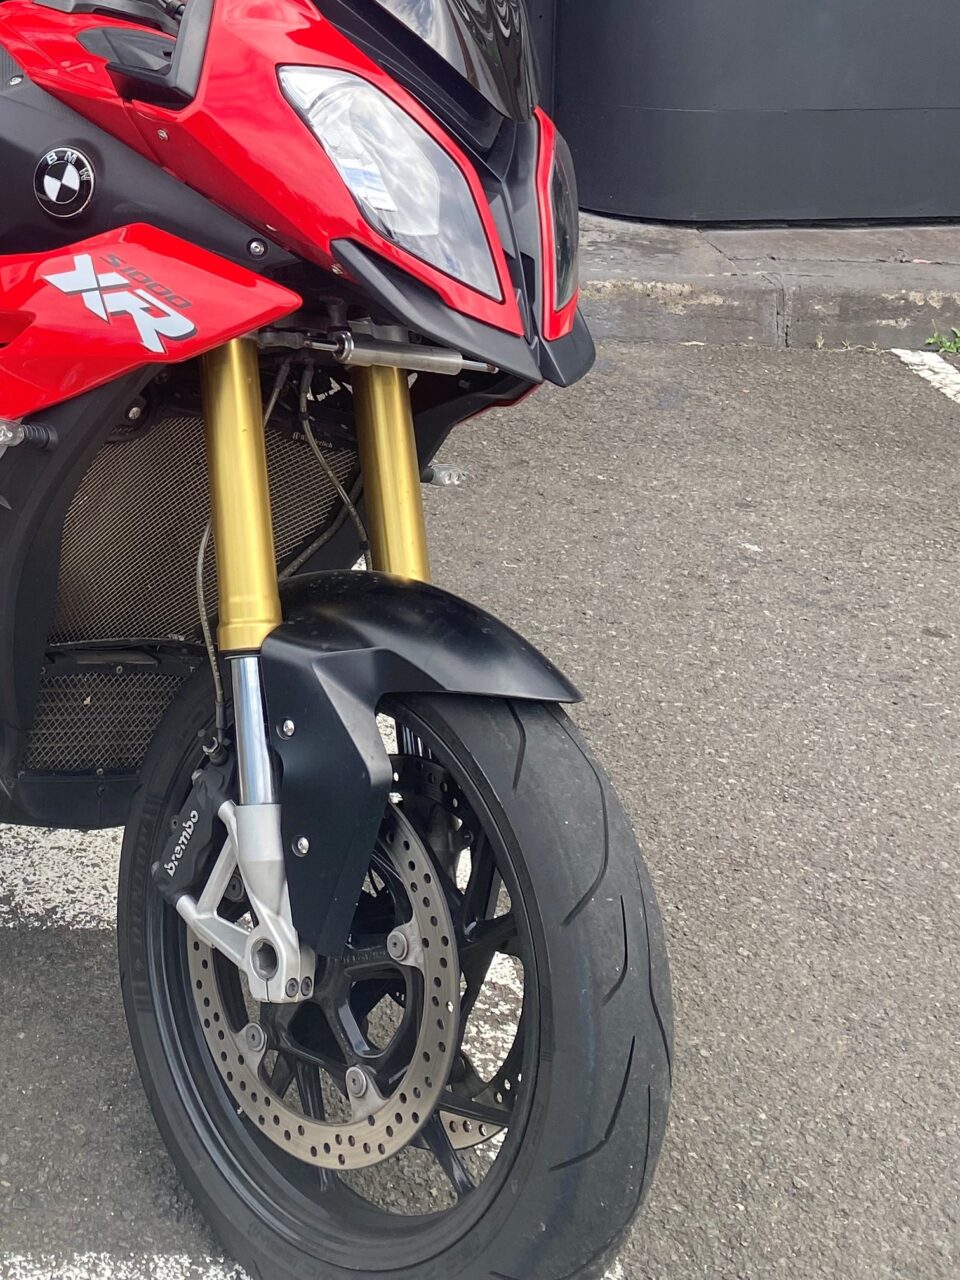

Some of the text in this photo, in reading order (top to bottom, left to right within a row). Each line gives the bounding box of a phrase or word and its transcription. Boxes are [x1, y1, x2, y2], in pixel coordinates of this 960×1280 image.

[45, 150, 92, 182] BMW
[41, 253, 197, 355] XR
[163, 809, 199, 878] brembo
